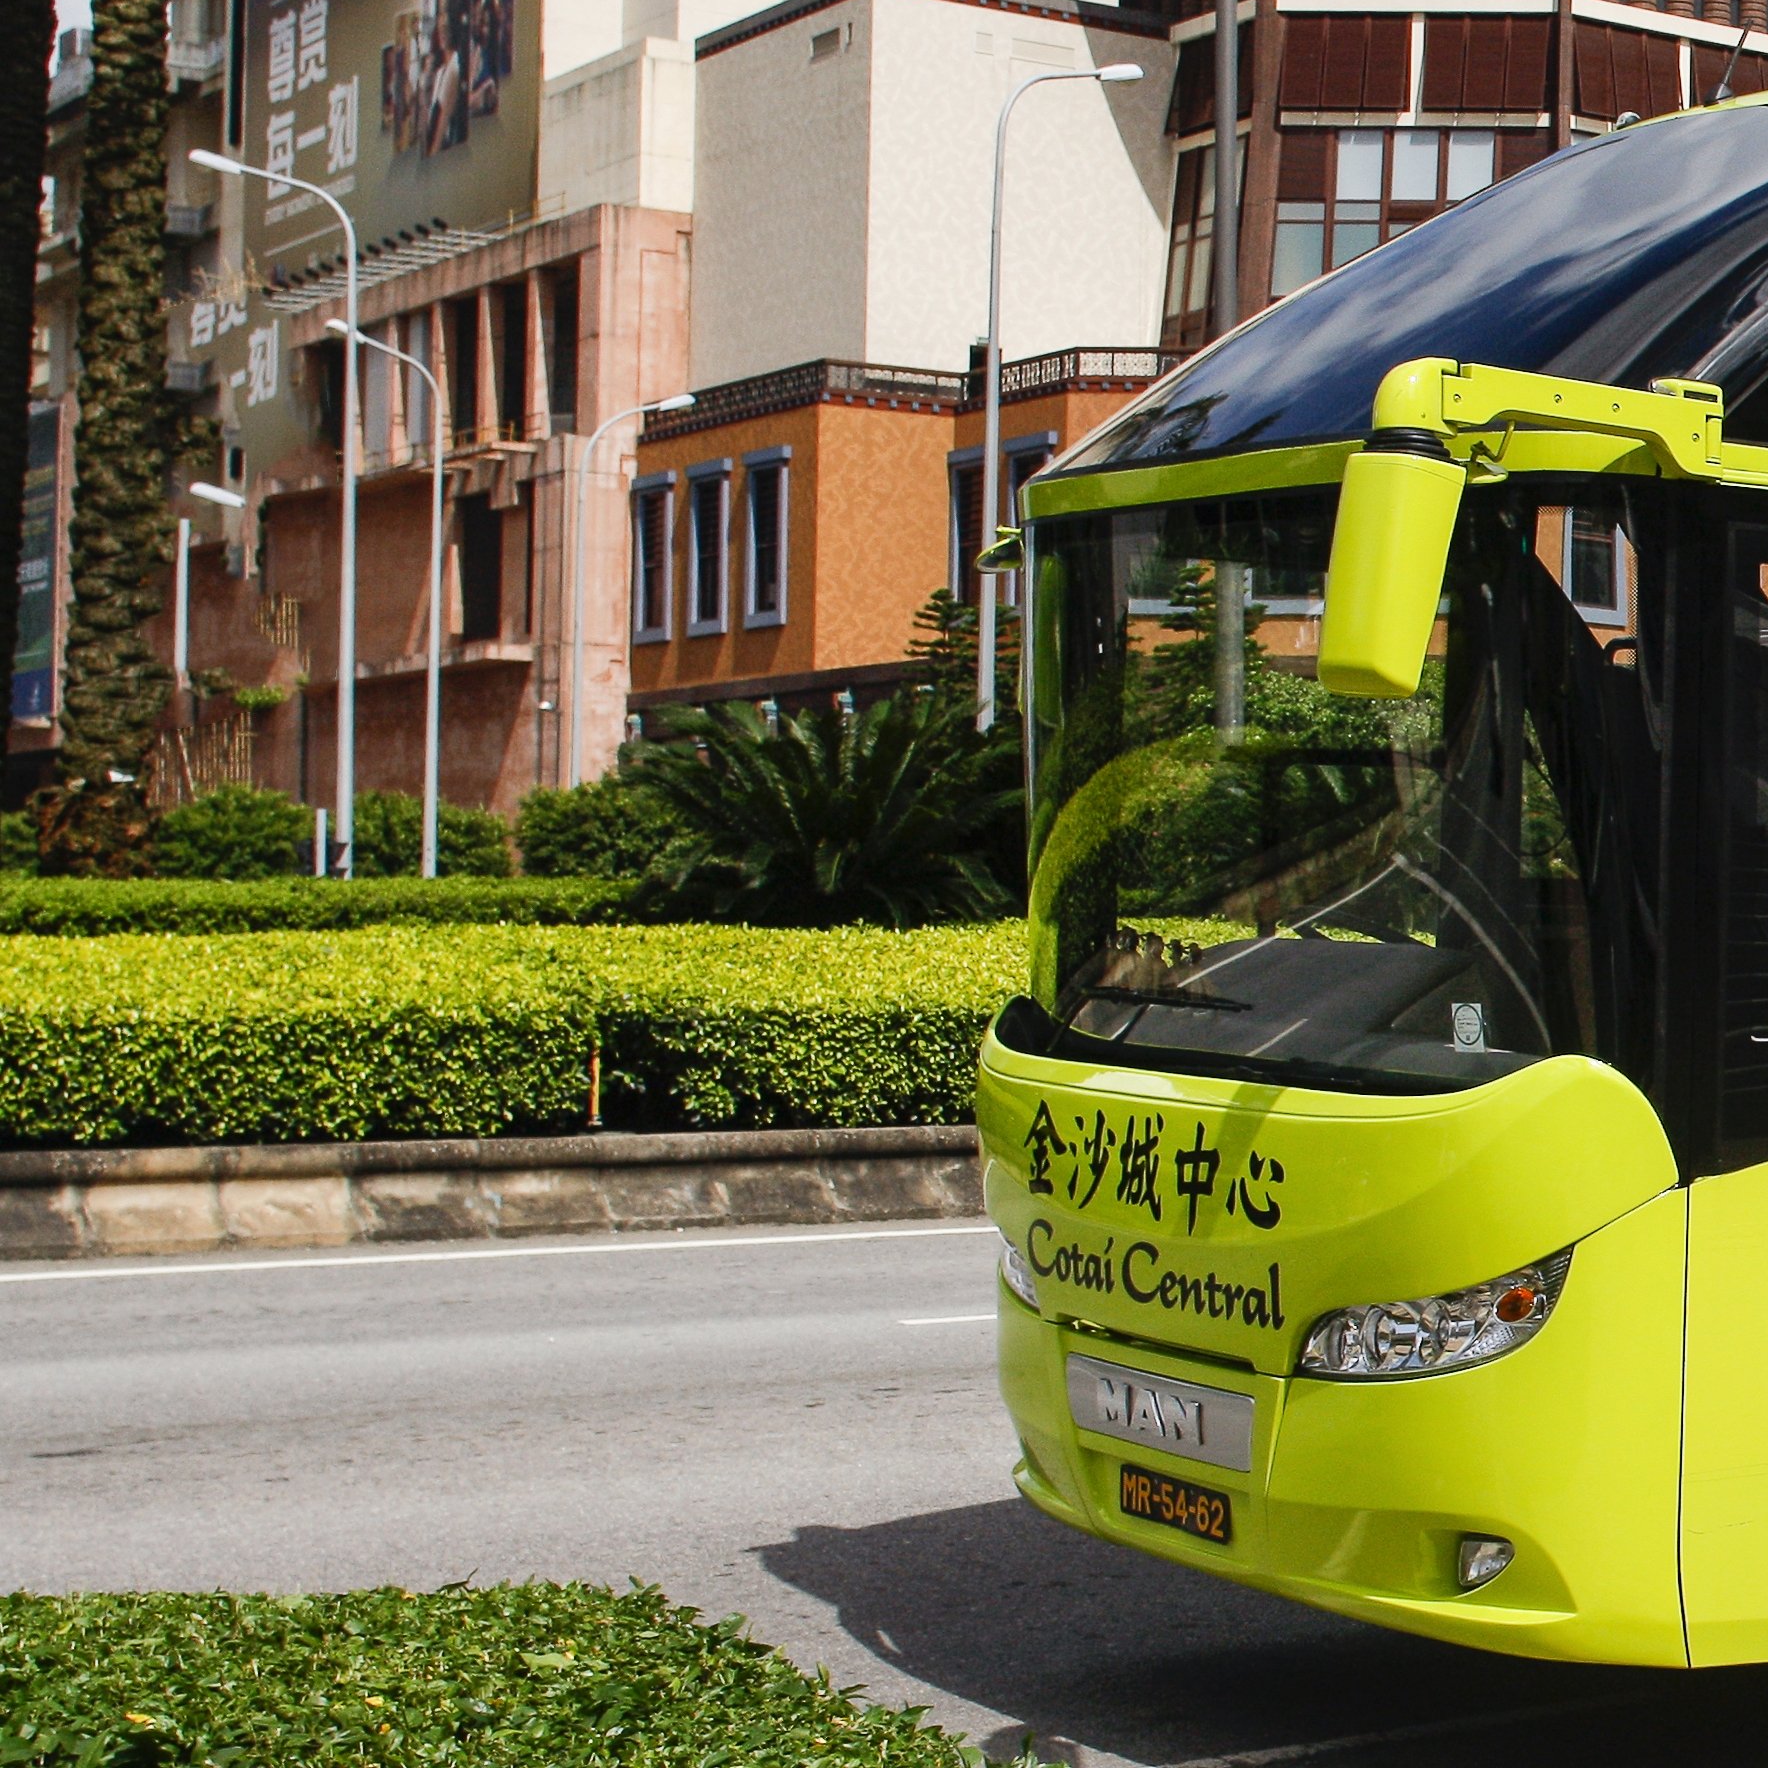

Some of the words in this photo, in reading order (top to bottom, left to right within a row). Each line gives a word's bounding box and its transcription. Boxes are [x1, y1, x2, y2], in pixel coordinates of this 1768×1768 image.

[1024, 1099, 1285, 1236] 金沙城中心
[1027, 1218, 1116, 1294] Cotai
[1121, 1241, 1285, 1330] Central
[1097, 1377, 1204, 1446] MAN
[1122, 1472, 1224, 1538] MR-54-62
